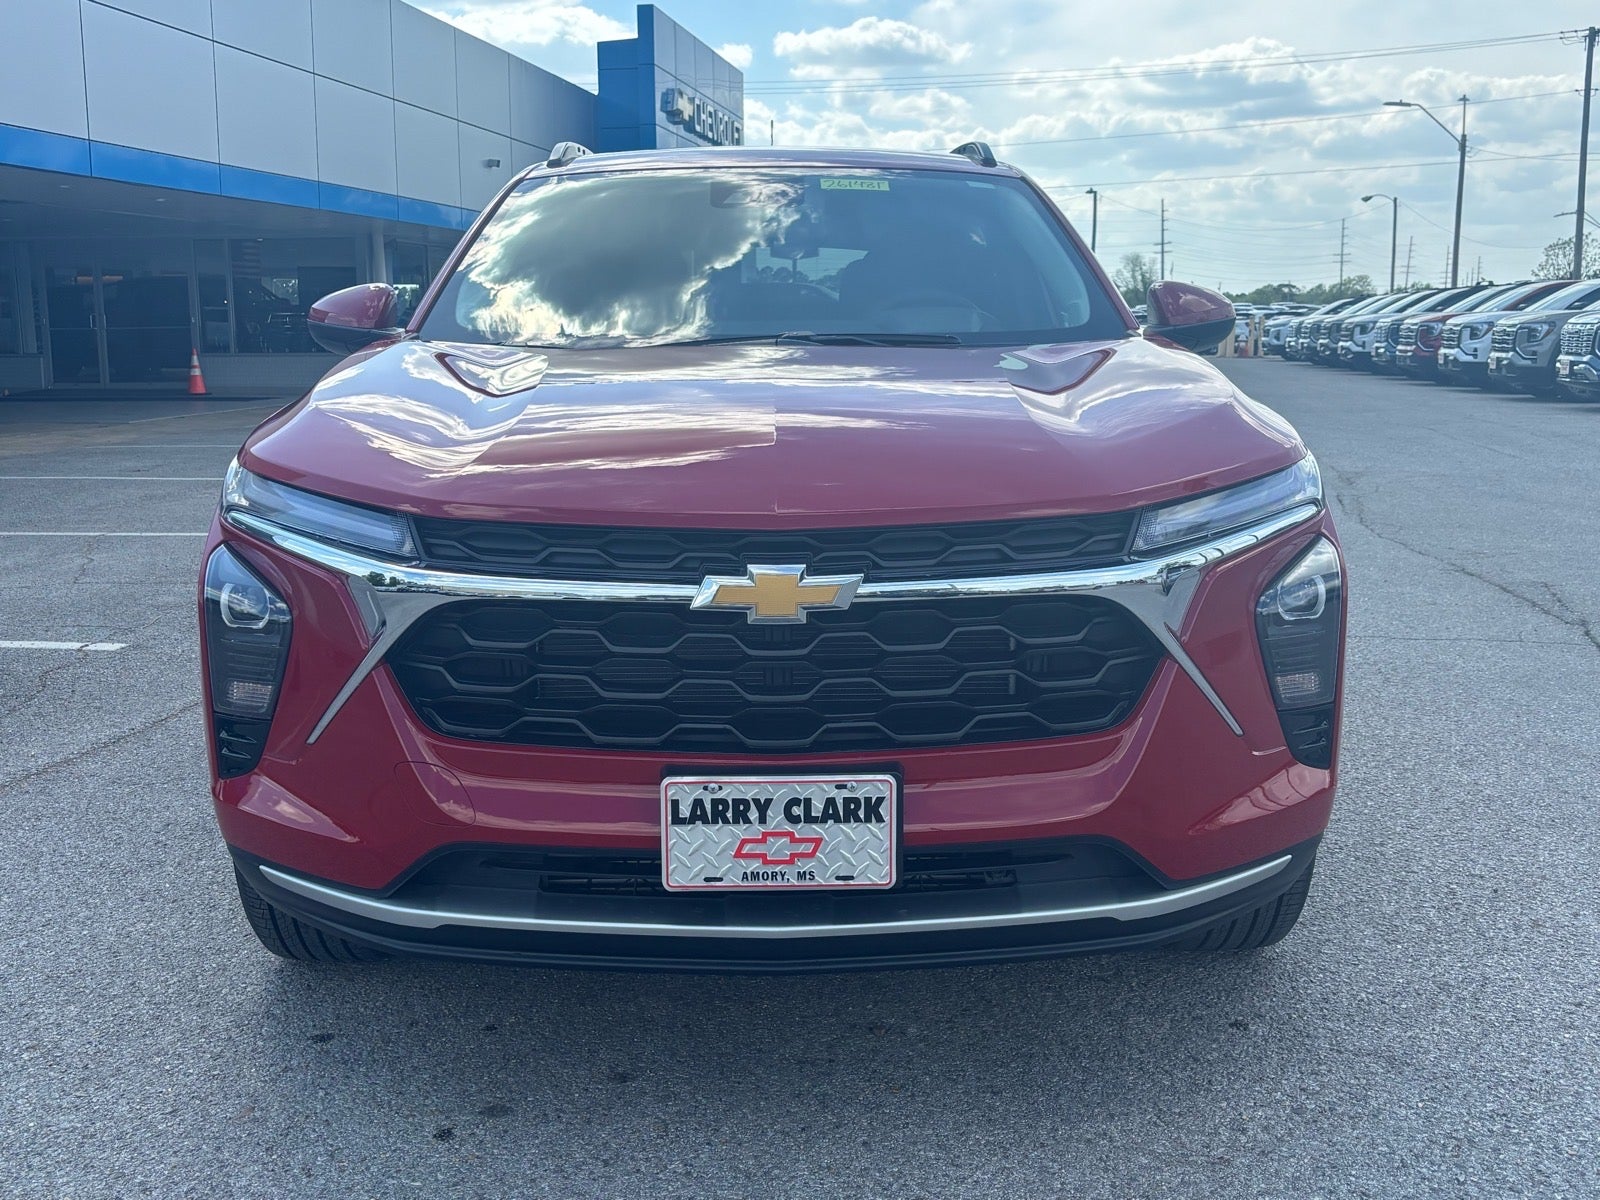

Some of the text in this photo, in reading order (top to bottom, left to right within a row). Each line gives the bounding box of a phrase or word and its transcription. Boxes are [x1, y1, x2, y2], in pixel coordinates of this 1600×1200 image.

[671, 796, 886, 825] LARRY CLARK
[741, 871, 816, 882] AMORY, MS
